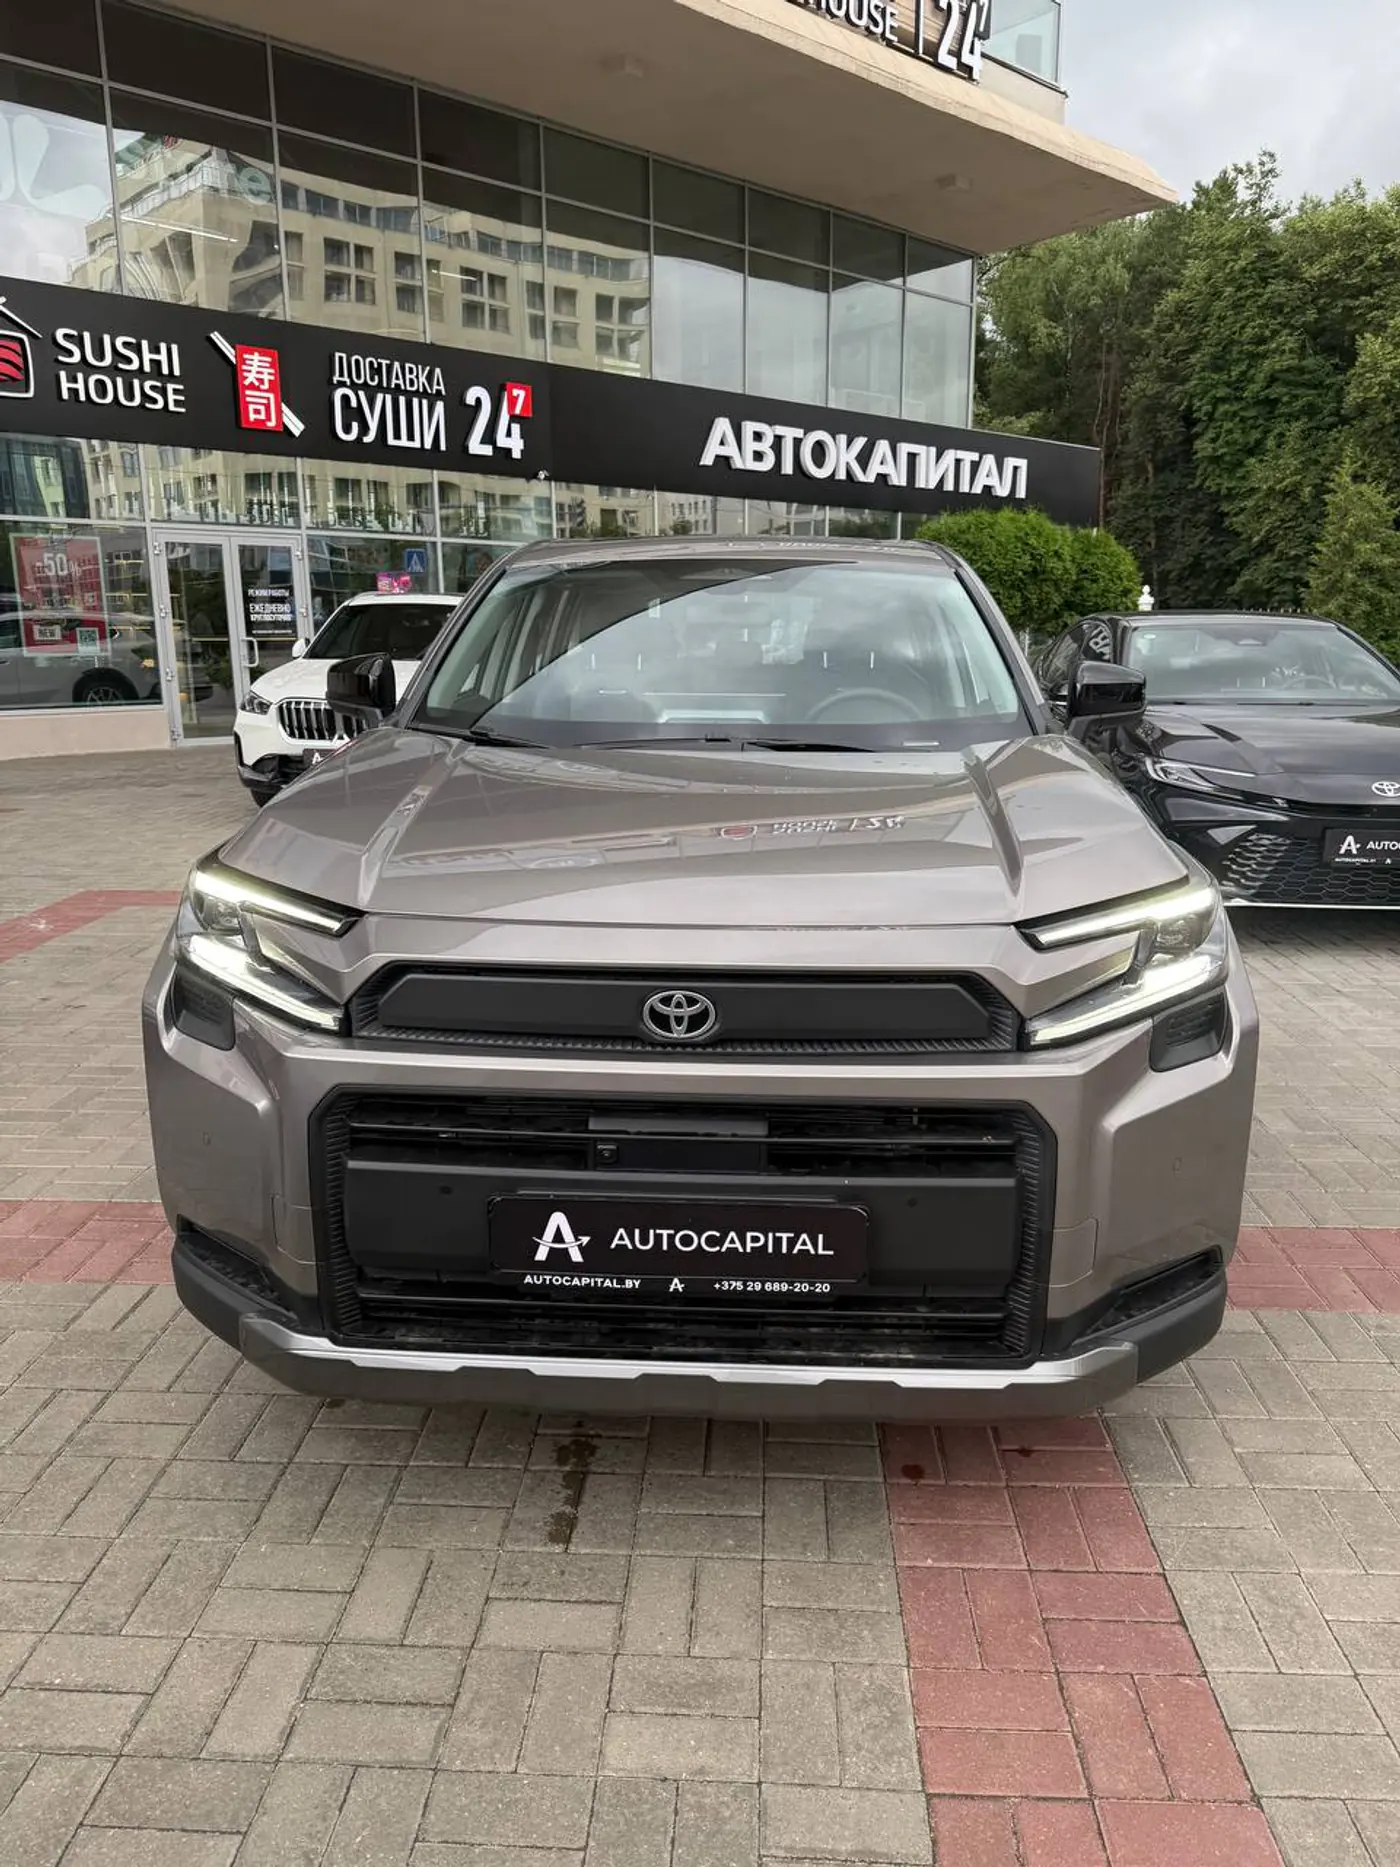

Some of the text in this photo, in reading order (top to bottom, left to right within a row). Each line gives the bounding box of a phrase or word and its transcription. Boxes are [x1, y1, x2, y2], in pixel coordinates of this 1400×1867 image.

[812, 0, 899, 42] USE
[54, 327, 181, 377] SUSHI
[333, 351, 446, 396] ДОСТАВКА
[59, 370, 187, 413] HOUSE
[241, 351, 277, 427] 寿司
[333, 386, 447, 452] СУШИ
[699, 416, 1029, 500] АВТОКАПИТАЛ
[1366, 840, 1400, 850] AUTO
[609, 1227, 835, 1257] AUTOCAPITAL
[523, 1274, 642, 1290] AUTOCAPITAL.BY
[713, 1280, 744, 1292] +375
[746, 1281, 762, 1292] 29
[764, 1281, 831, 1294] 689-20-20
